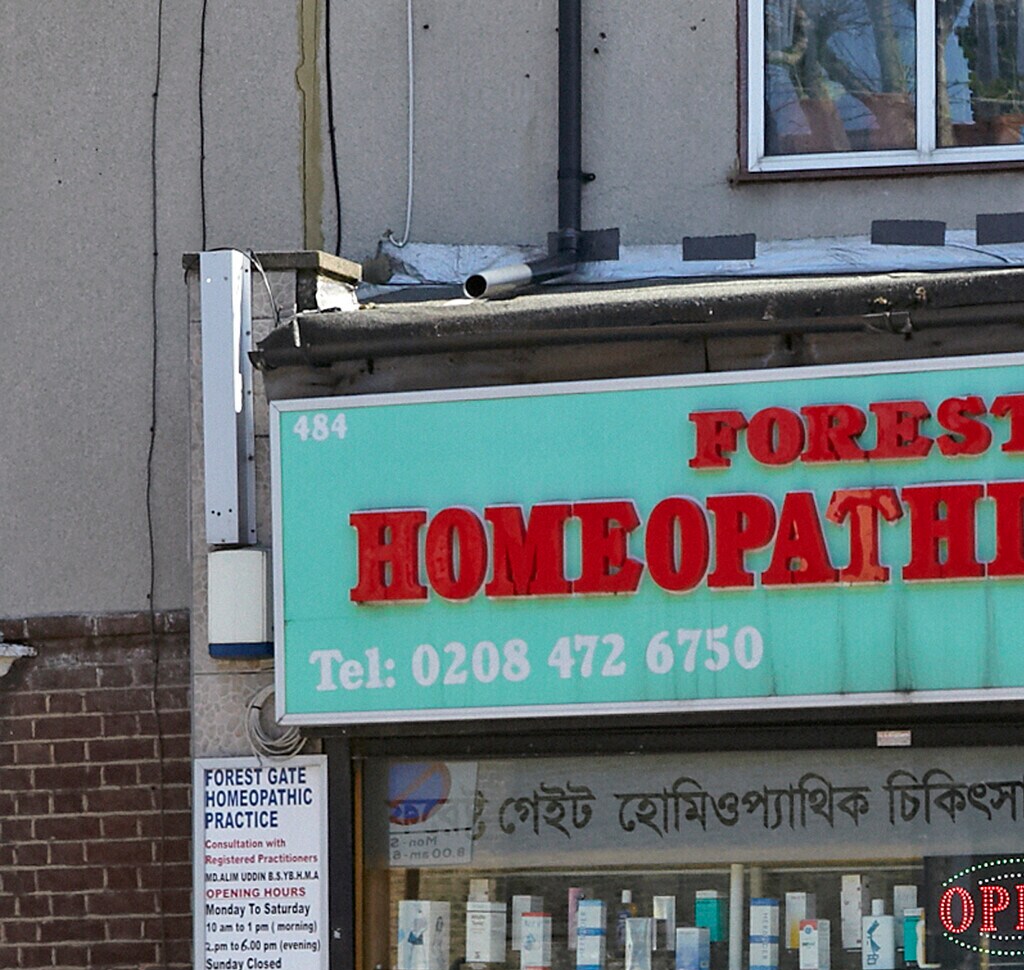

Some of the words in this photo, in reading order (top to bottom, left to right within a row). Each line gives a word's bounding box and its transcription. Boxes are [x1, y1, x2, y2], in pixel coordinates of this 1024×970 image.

[292, 412, 347, 441] 484
[310, 646, 396, 693] Tel:
[411, 637, 531, 686] 0208
[547, 633, 626, 681] 472
[645, 625, 764, 676] 6750
[204, 768, 262, 786] FOREST
[268, 767, 306, 785] GATE
[205, 788, 313, 807] HOMEOPATHIC
[499, 781, 597, 839] গেইট
[614, 772, 871, 838] হোমিওপ্যাথিক
[205, 811, 278, 829] PRACTICE
[205, 838, 263, 850] Consultation
[266, 838, 286, 848] with
[205, 855, 255, 867] Registered
[258, 853, 318, 864] Practitioners
[241, 872, 266, 882] UDDIN
[206, 888, 260, 898] OPENING
[264, 887, 306, 897] HOURS
[206, 903, 246, 918] Monday
[249, 903, 261, 914] To
[264, 902, 311, 917] Saturday
[206, 922, 217, 932] 10
[220, 923, 233, 932] am
[235, 922, 245, 932] to
[255, 923, 269, 934] pm
[230, 941, 239, 951] to
[263, 941, 277, 952] pm
[280, 940, 320, 952] (evening)
[247, 957, 282, 970] Closed
